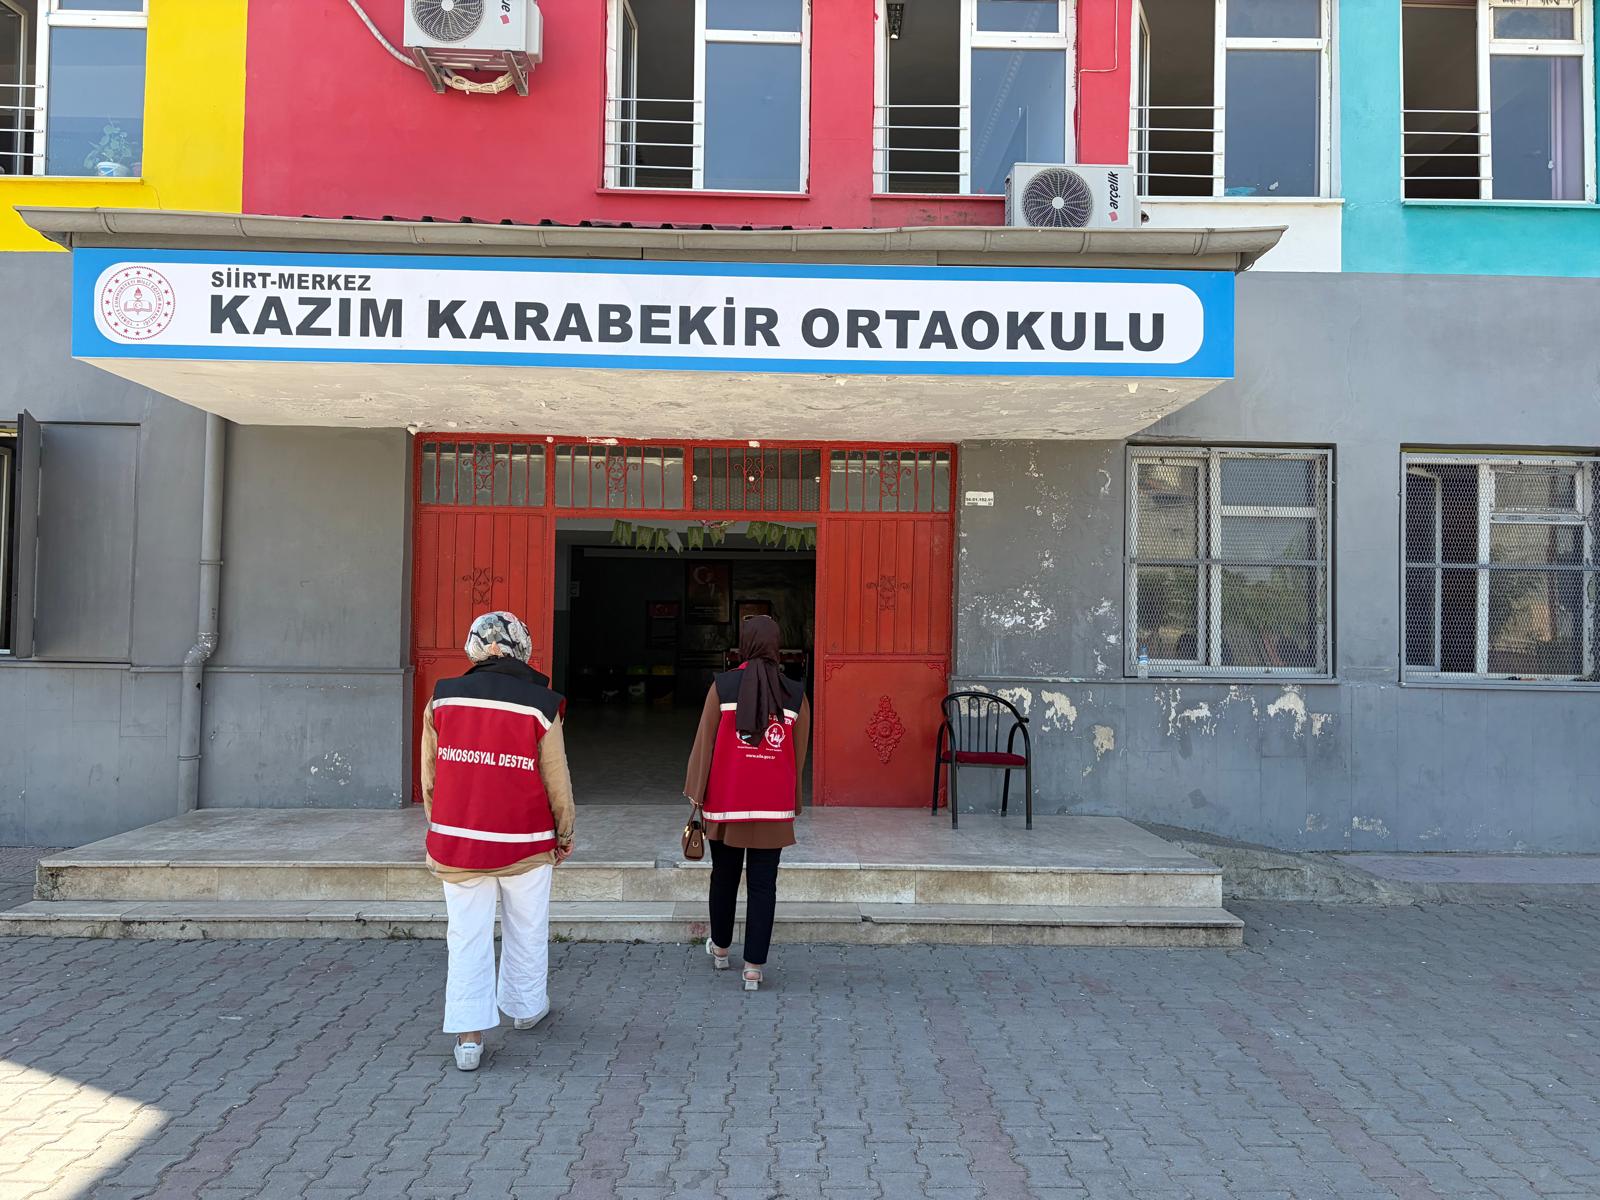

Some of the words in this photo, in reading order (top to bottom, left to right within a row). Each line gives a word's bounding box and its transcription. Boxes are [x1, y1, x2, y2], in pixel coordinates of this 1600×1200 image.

[1108, 171, 1120, 209] arçelik
[211, 267, 371, 291] SİİRT-MERKEZ
[211, 294, 402, 338] KAZIM
[428, 297, 779, 347] KARABEKİR
[801, 309, 1164, 352] ORTAOKULU
[438, 745, 496, 765] PSİKOSOSYAL
[498, 753, 535, 771] DESTEK
